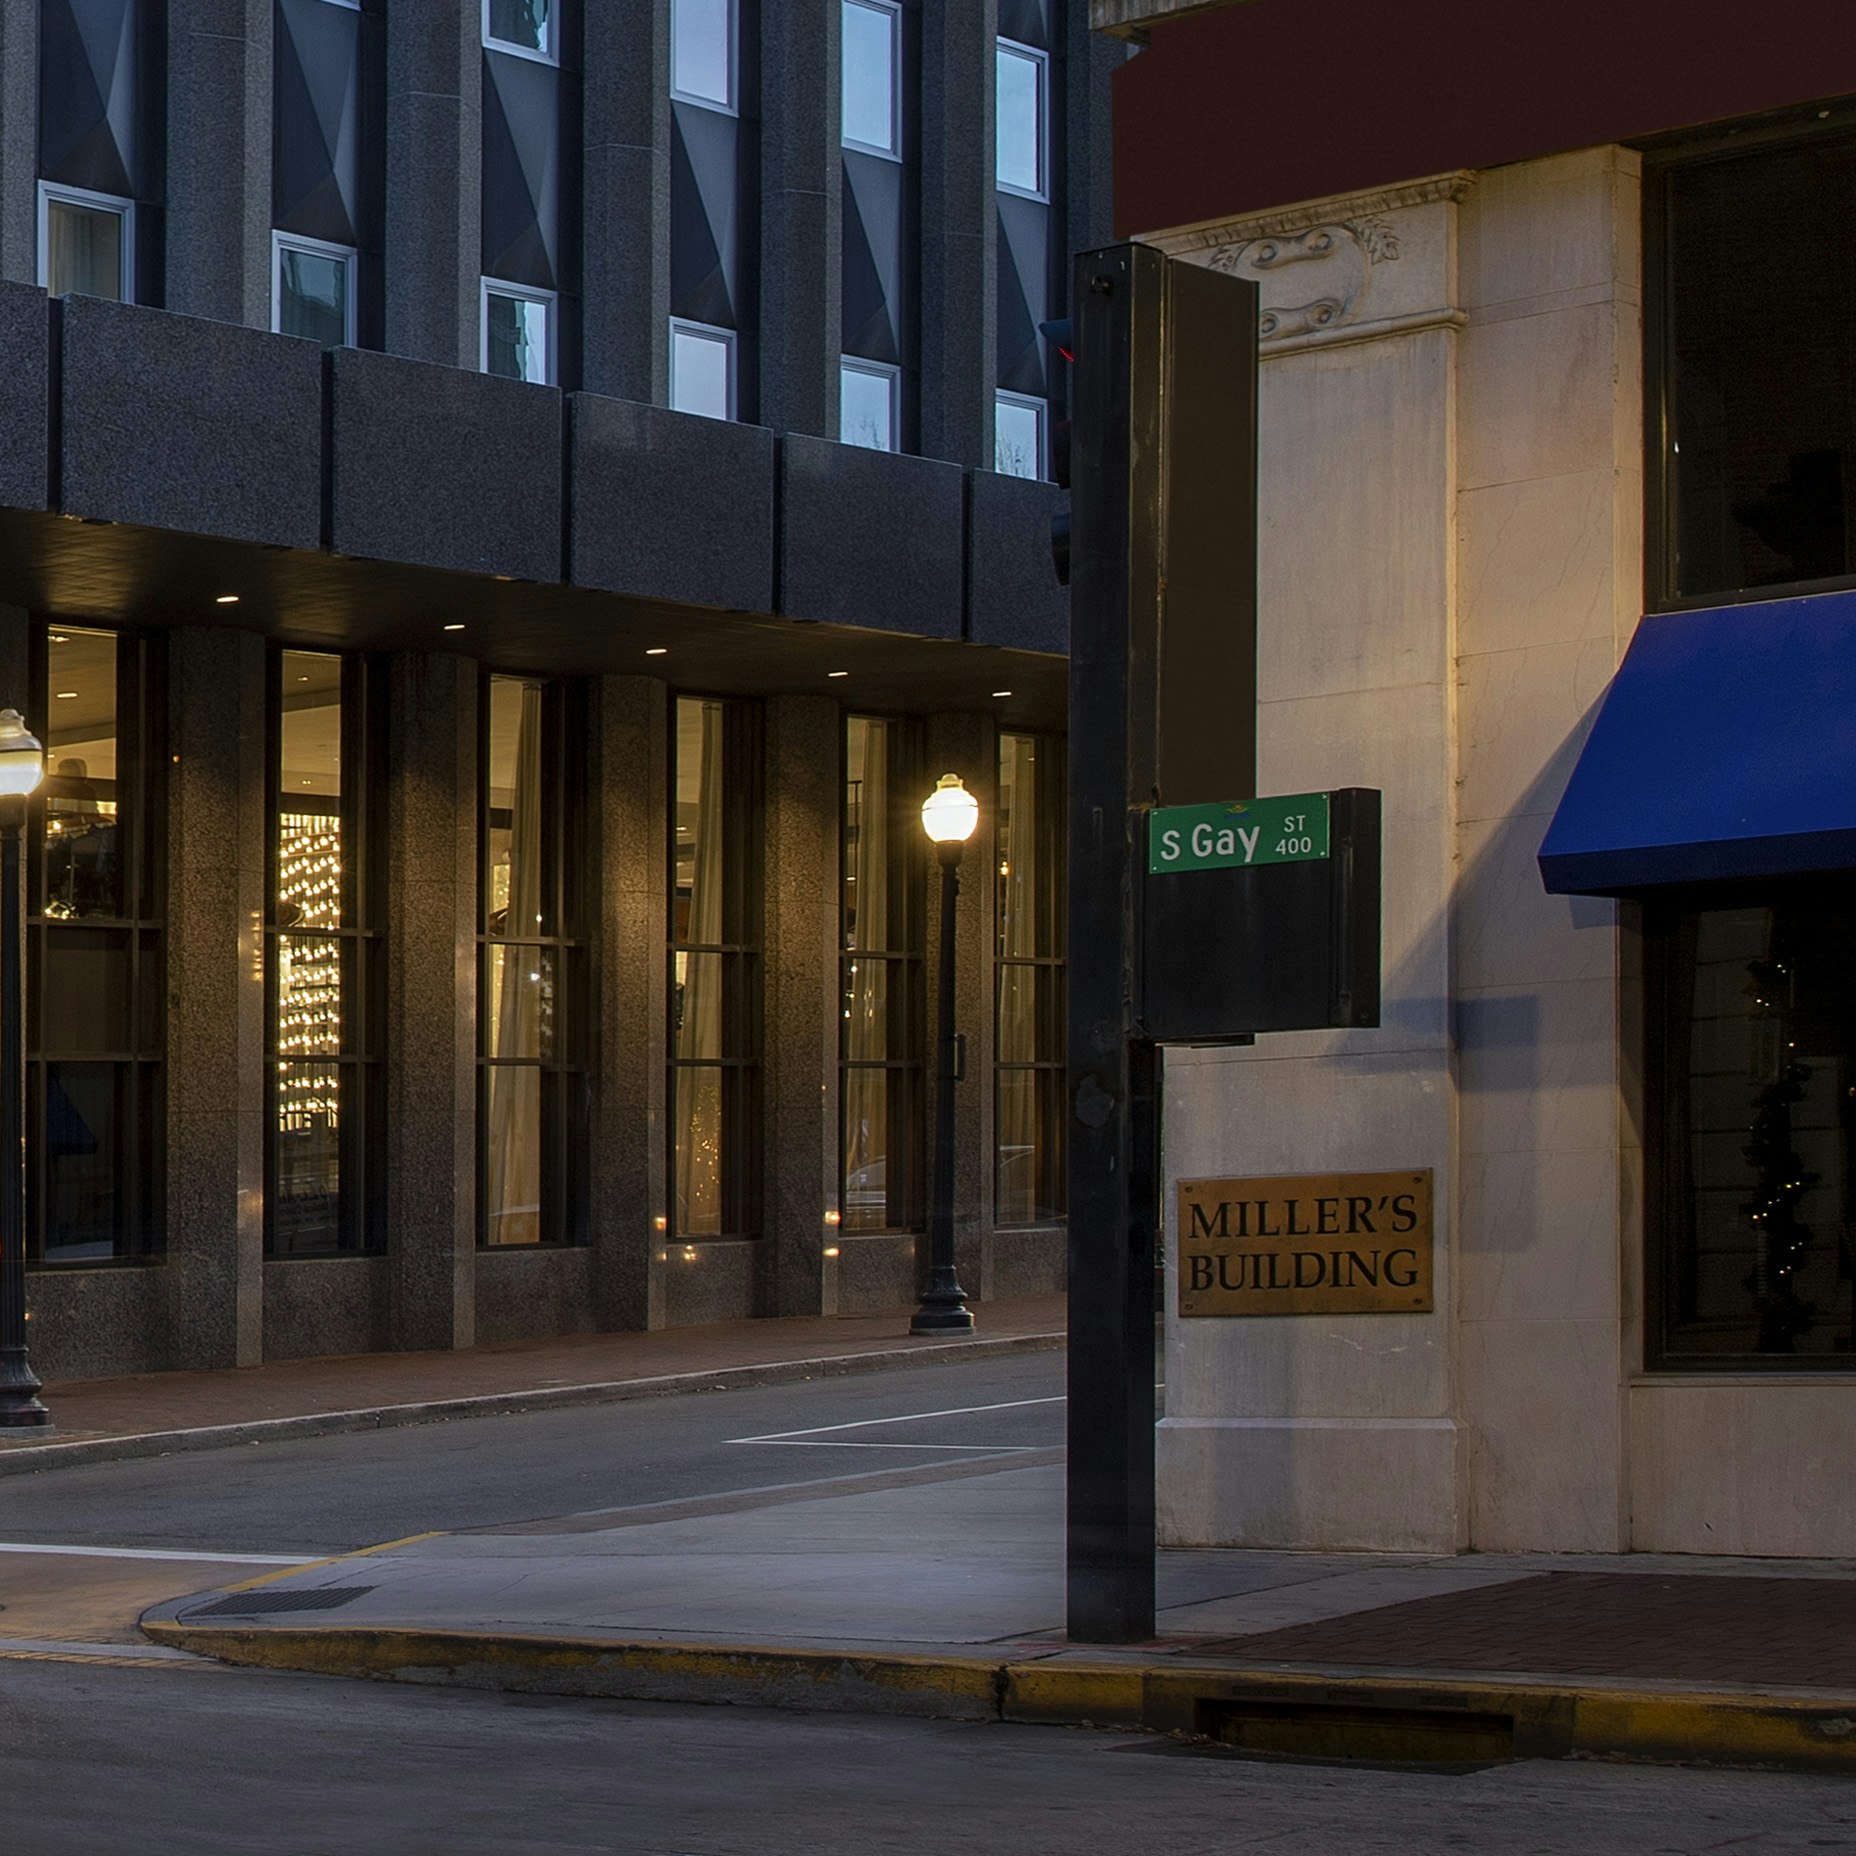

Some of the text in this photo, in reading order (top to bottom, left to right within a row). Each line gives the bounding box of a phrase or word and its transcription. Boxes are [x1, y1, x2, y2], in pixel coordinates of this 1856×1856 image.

[1160, 815, 1306, 864] S Gay ST
[1274, 836, 1312, 856] 400
[1187, 1194, 1418, 1239] MILLER'S
[1187, 1248, 1419, 1292] BUILDING
